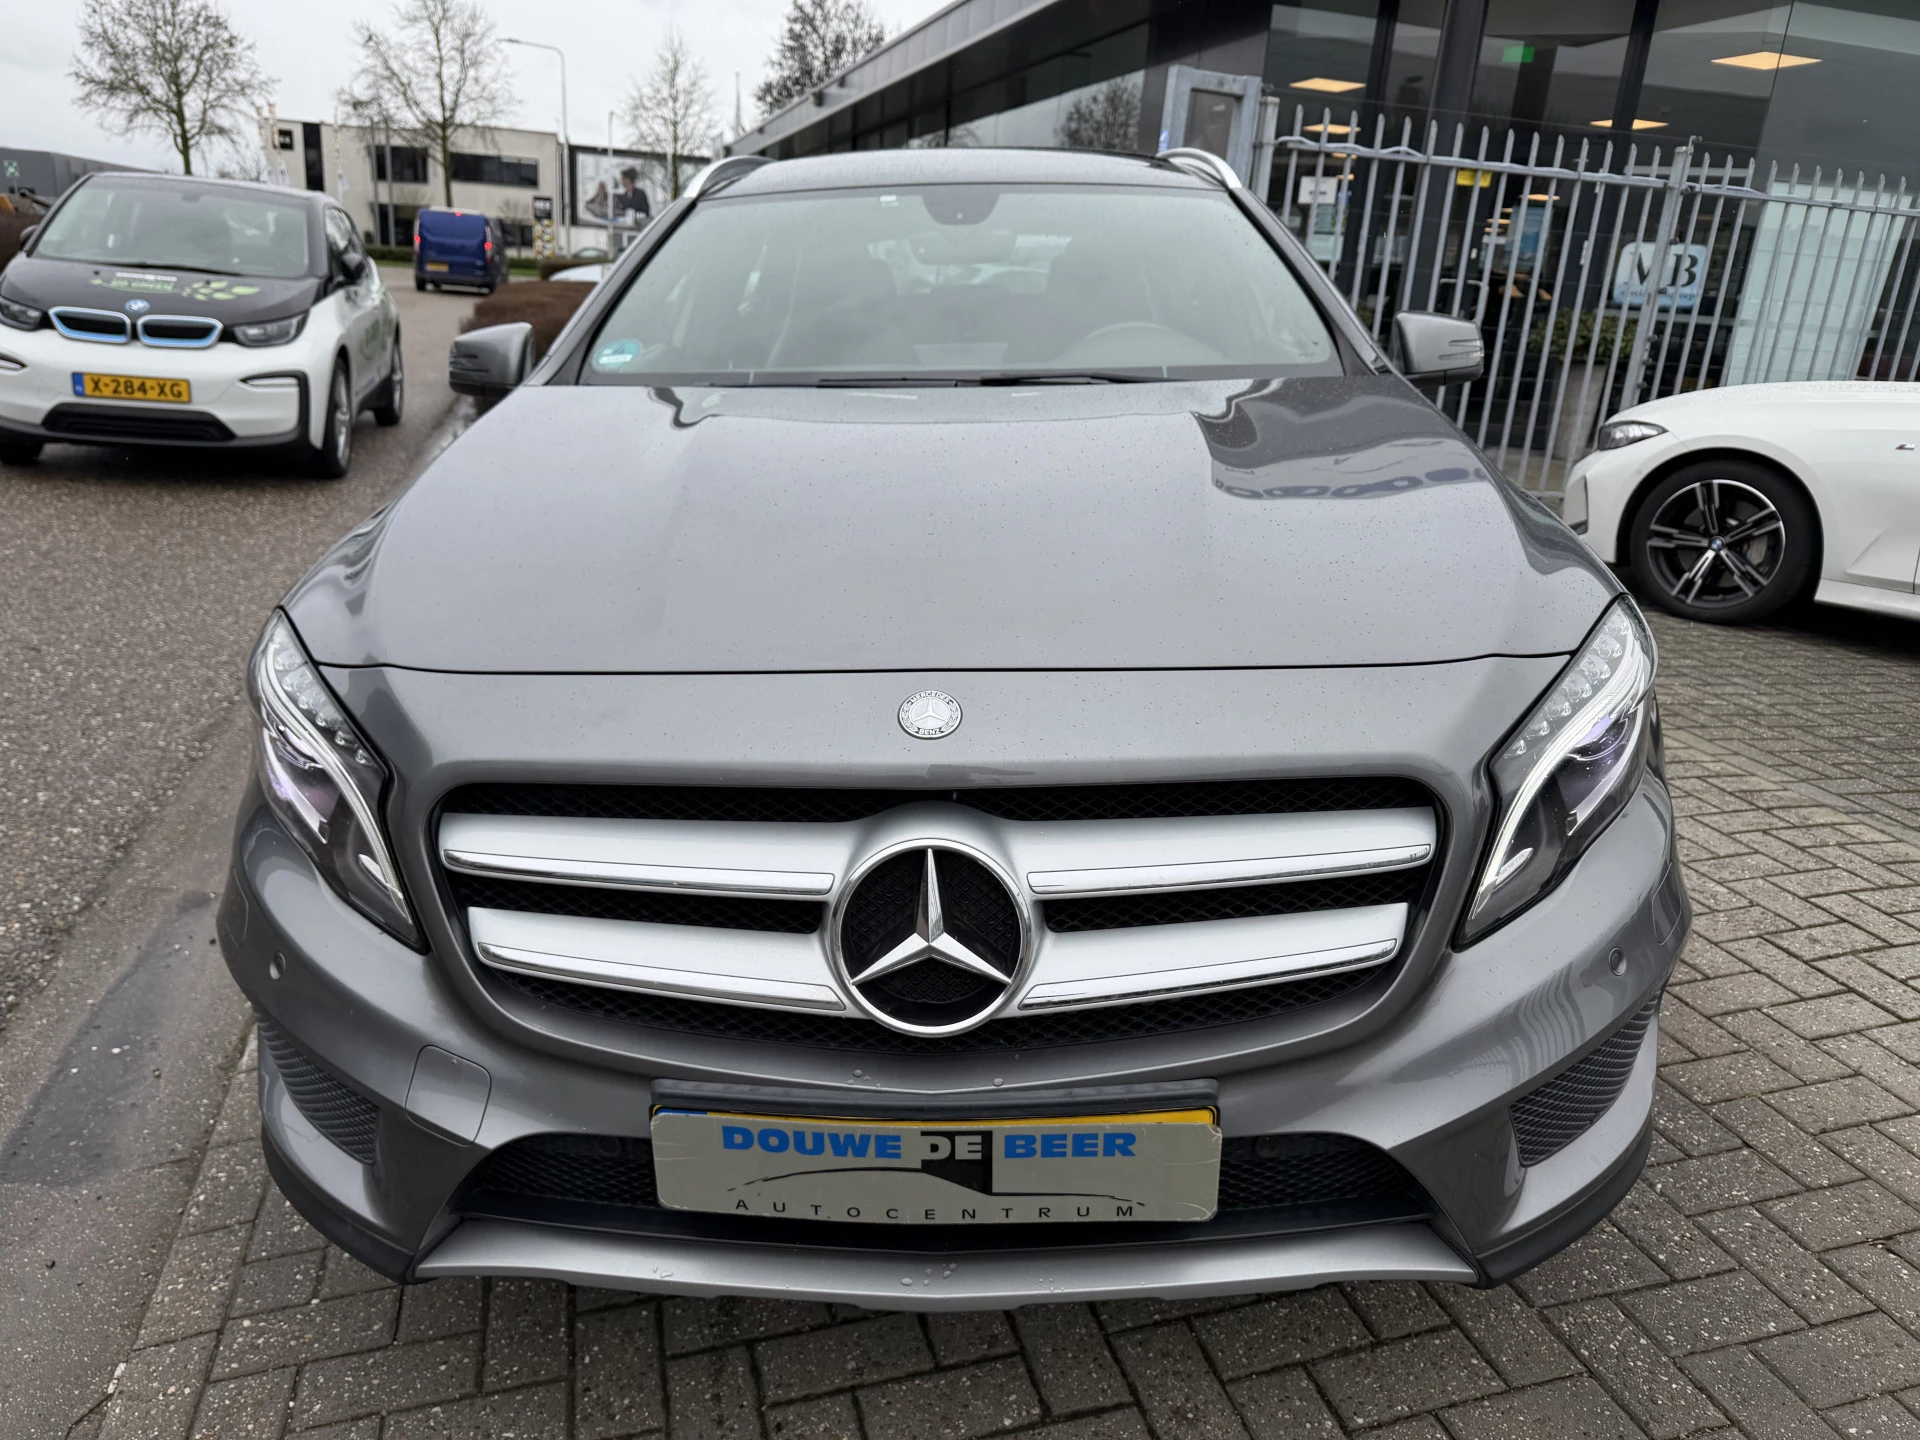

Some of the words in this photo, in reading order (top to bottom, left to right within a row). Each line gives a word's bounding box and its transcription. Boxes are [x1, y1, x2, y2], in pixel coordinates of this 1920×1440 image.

[90, 376, 183, 398] X-284-XG
[722, 1125, 902, 1159] DOUWE
[920, 1134, 983, 1161] DE
[1004, 1132, 1137, 1159] BEER
[735, 1199, 1133, 1220] AUTOCENTRUM
